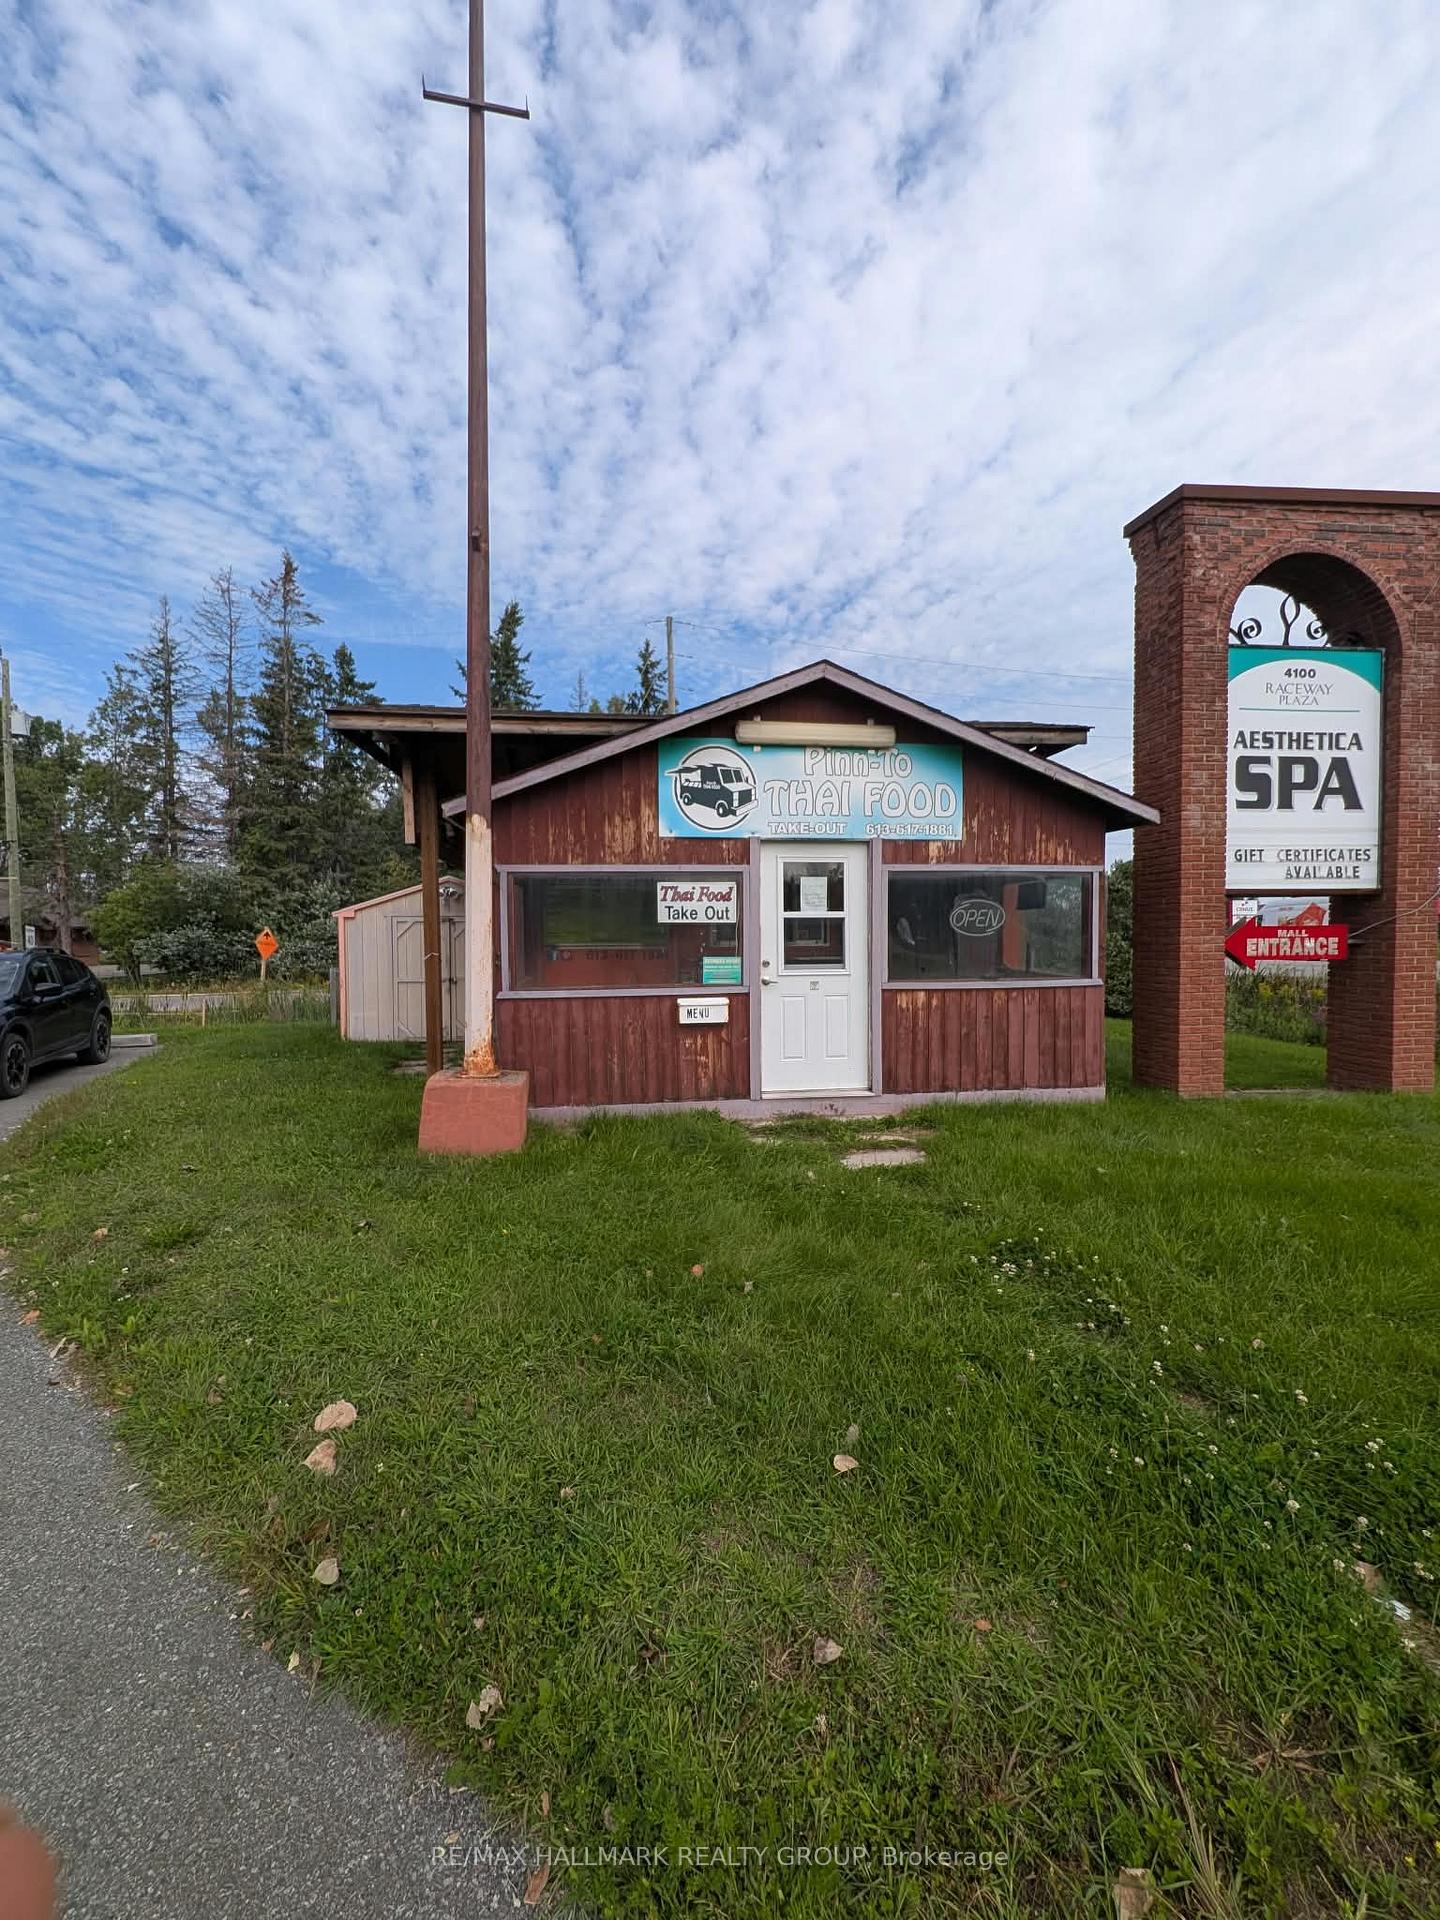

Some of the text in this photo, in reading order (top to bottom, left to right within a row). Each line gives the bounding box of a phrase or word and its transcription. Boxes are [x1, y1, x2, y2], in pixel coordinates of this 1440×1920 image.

[1284, 668, 1316, 679] 4100
[1265, 682, 1334, 696] RACEWAY
[1279, 695, 1320, 706] PLAZA
[1233, 730, 1363, 751] AESTHETICA
[804, 747, 913, 778] Pinn-To
[1235, 755, 1364, 811] SPA
[764, 779, 957, 818] THAI FOOD
[768, 821, 954, 836] TAKE-OUT 613-617-1881
[1234, 849, 1371, 863] GIFT CERTIFICATES
[660, 886, 734, 902] Thai Food
[665, 905, 730, 920] Take Out
[953, 909, 1001, 927] OPEN
[1277, 929, 1309, 938] MALL
[1246, 937, 1339, 957] ENTRANCE
[686, 1008, 710, 1019] MENU
